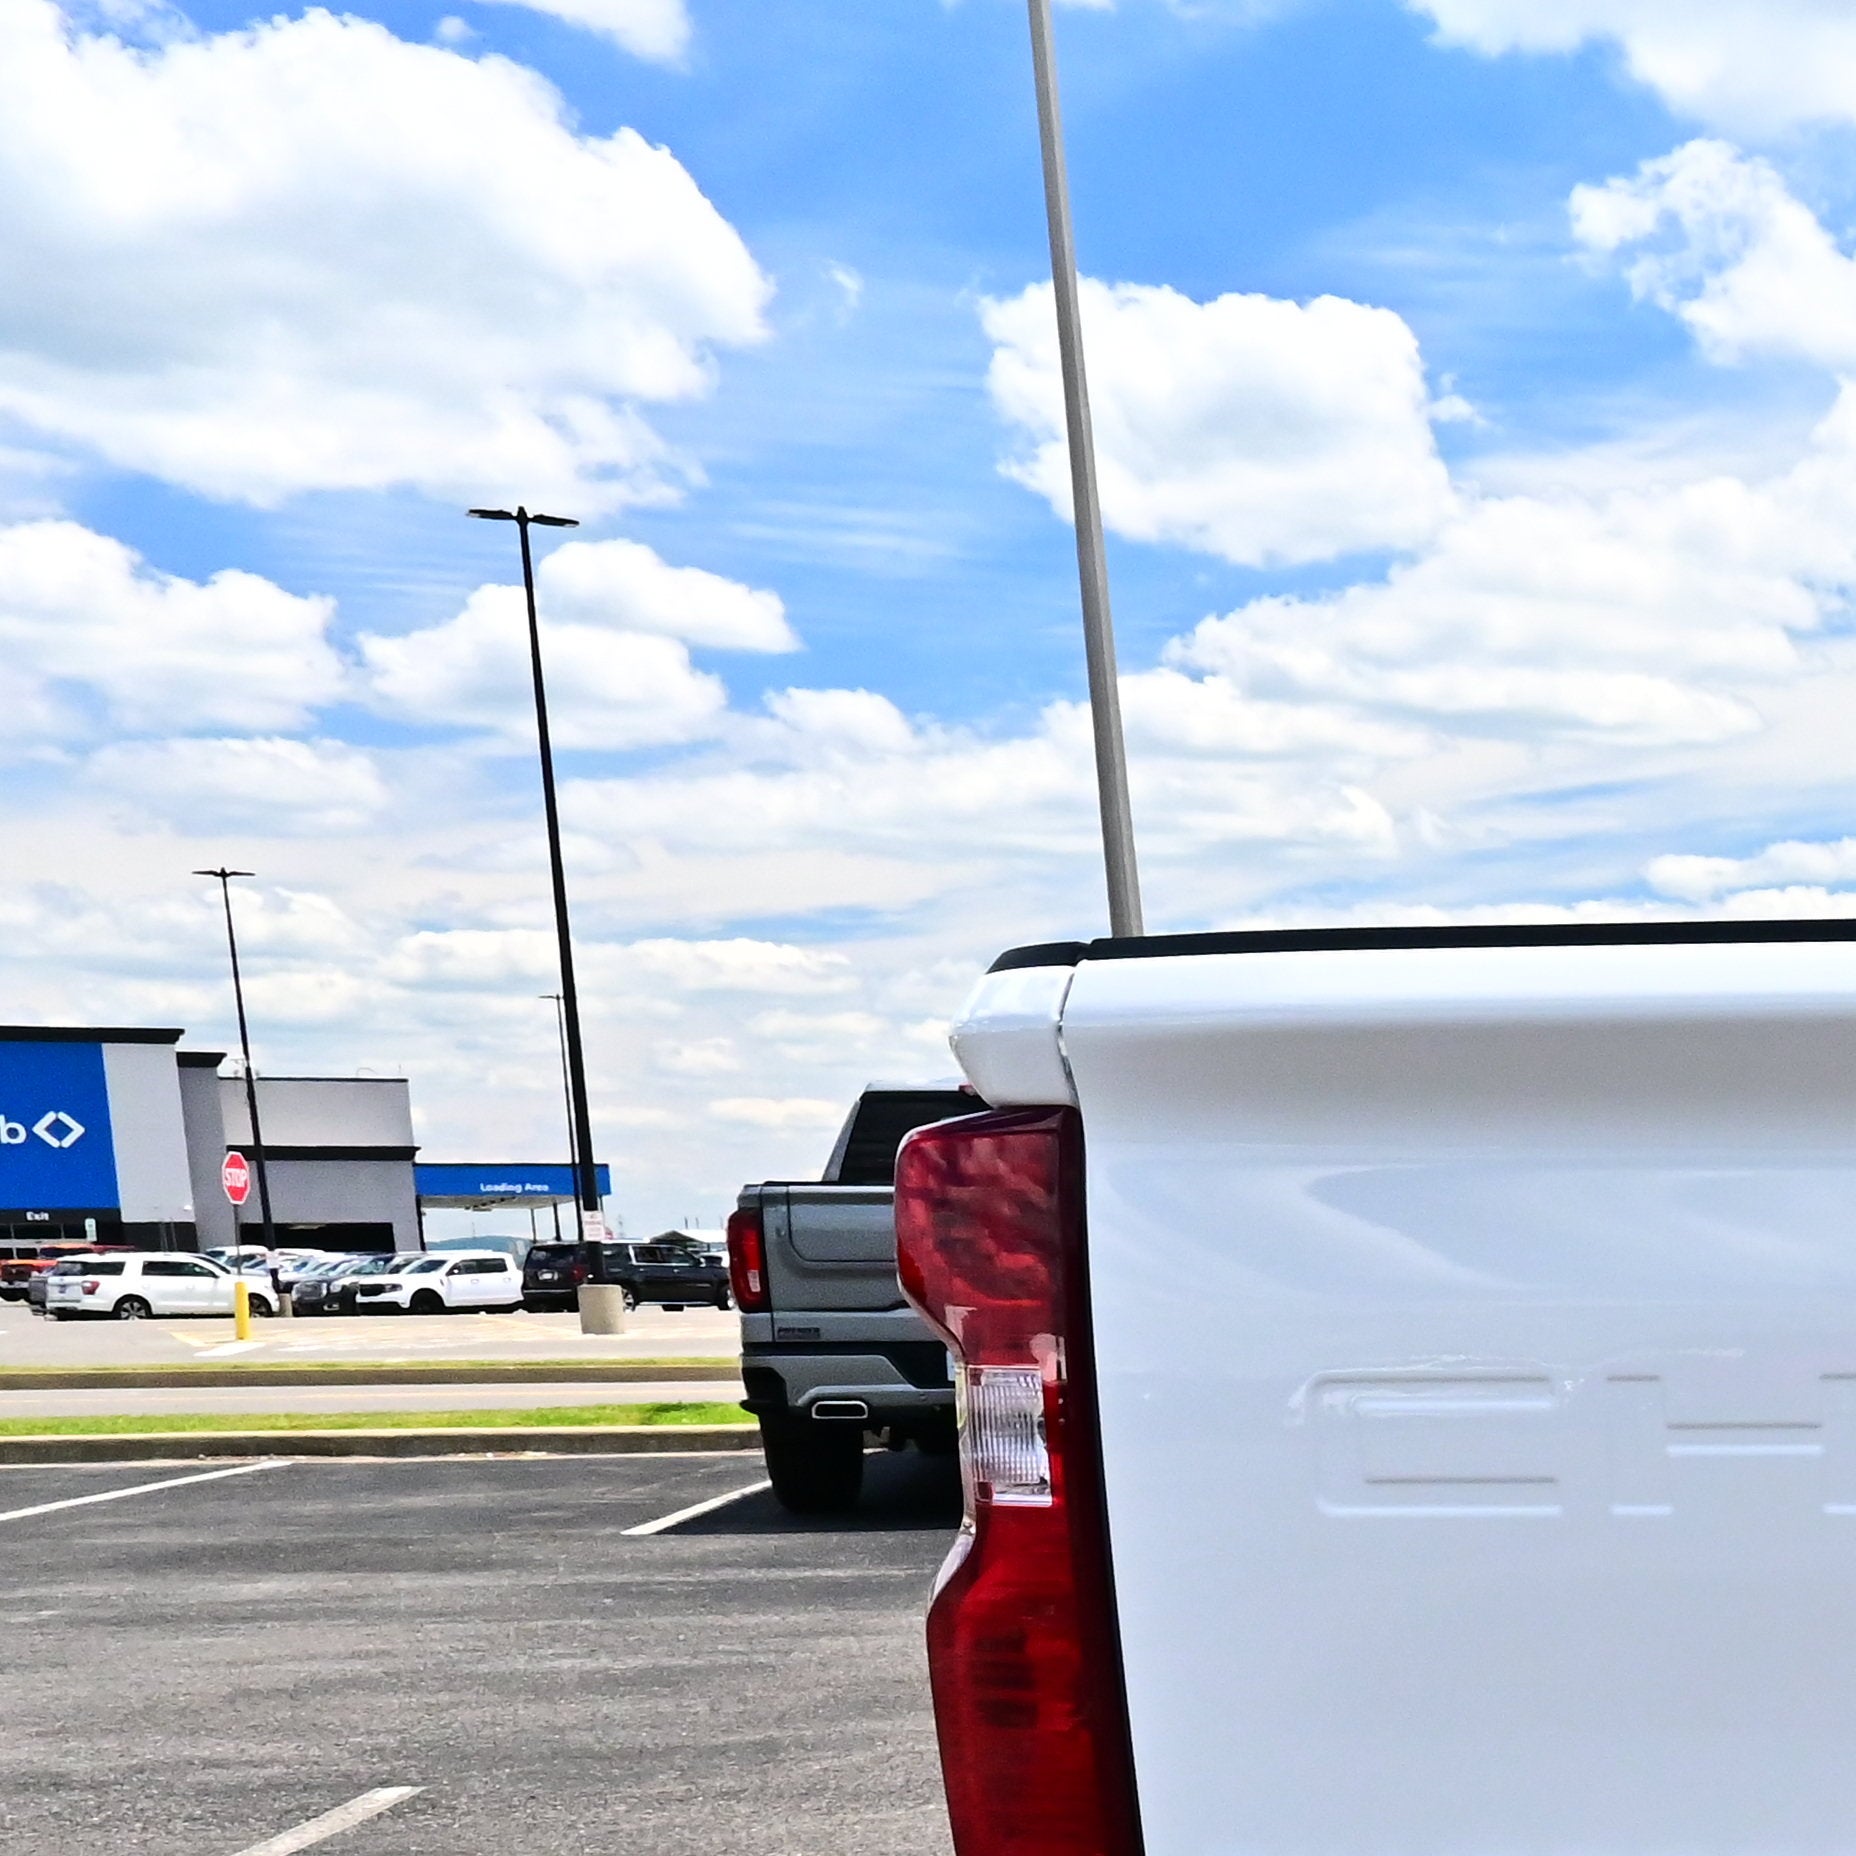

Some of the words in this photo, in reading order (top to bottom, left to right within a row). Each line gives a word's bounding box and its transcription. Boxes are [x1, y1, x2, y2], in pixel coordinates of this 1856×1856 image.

[225, 1168, 247, 1186] STOP
[480, 1183, 522, 1193] Loading
[525, 1183, 549, 1191] Area
[27, 1211, 49, 1221] Exit
